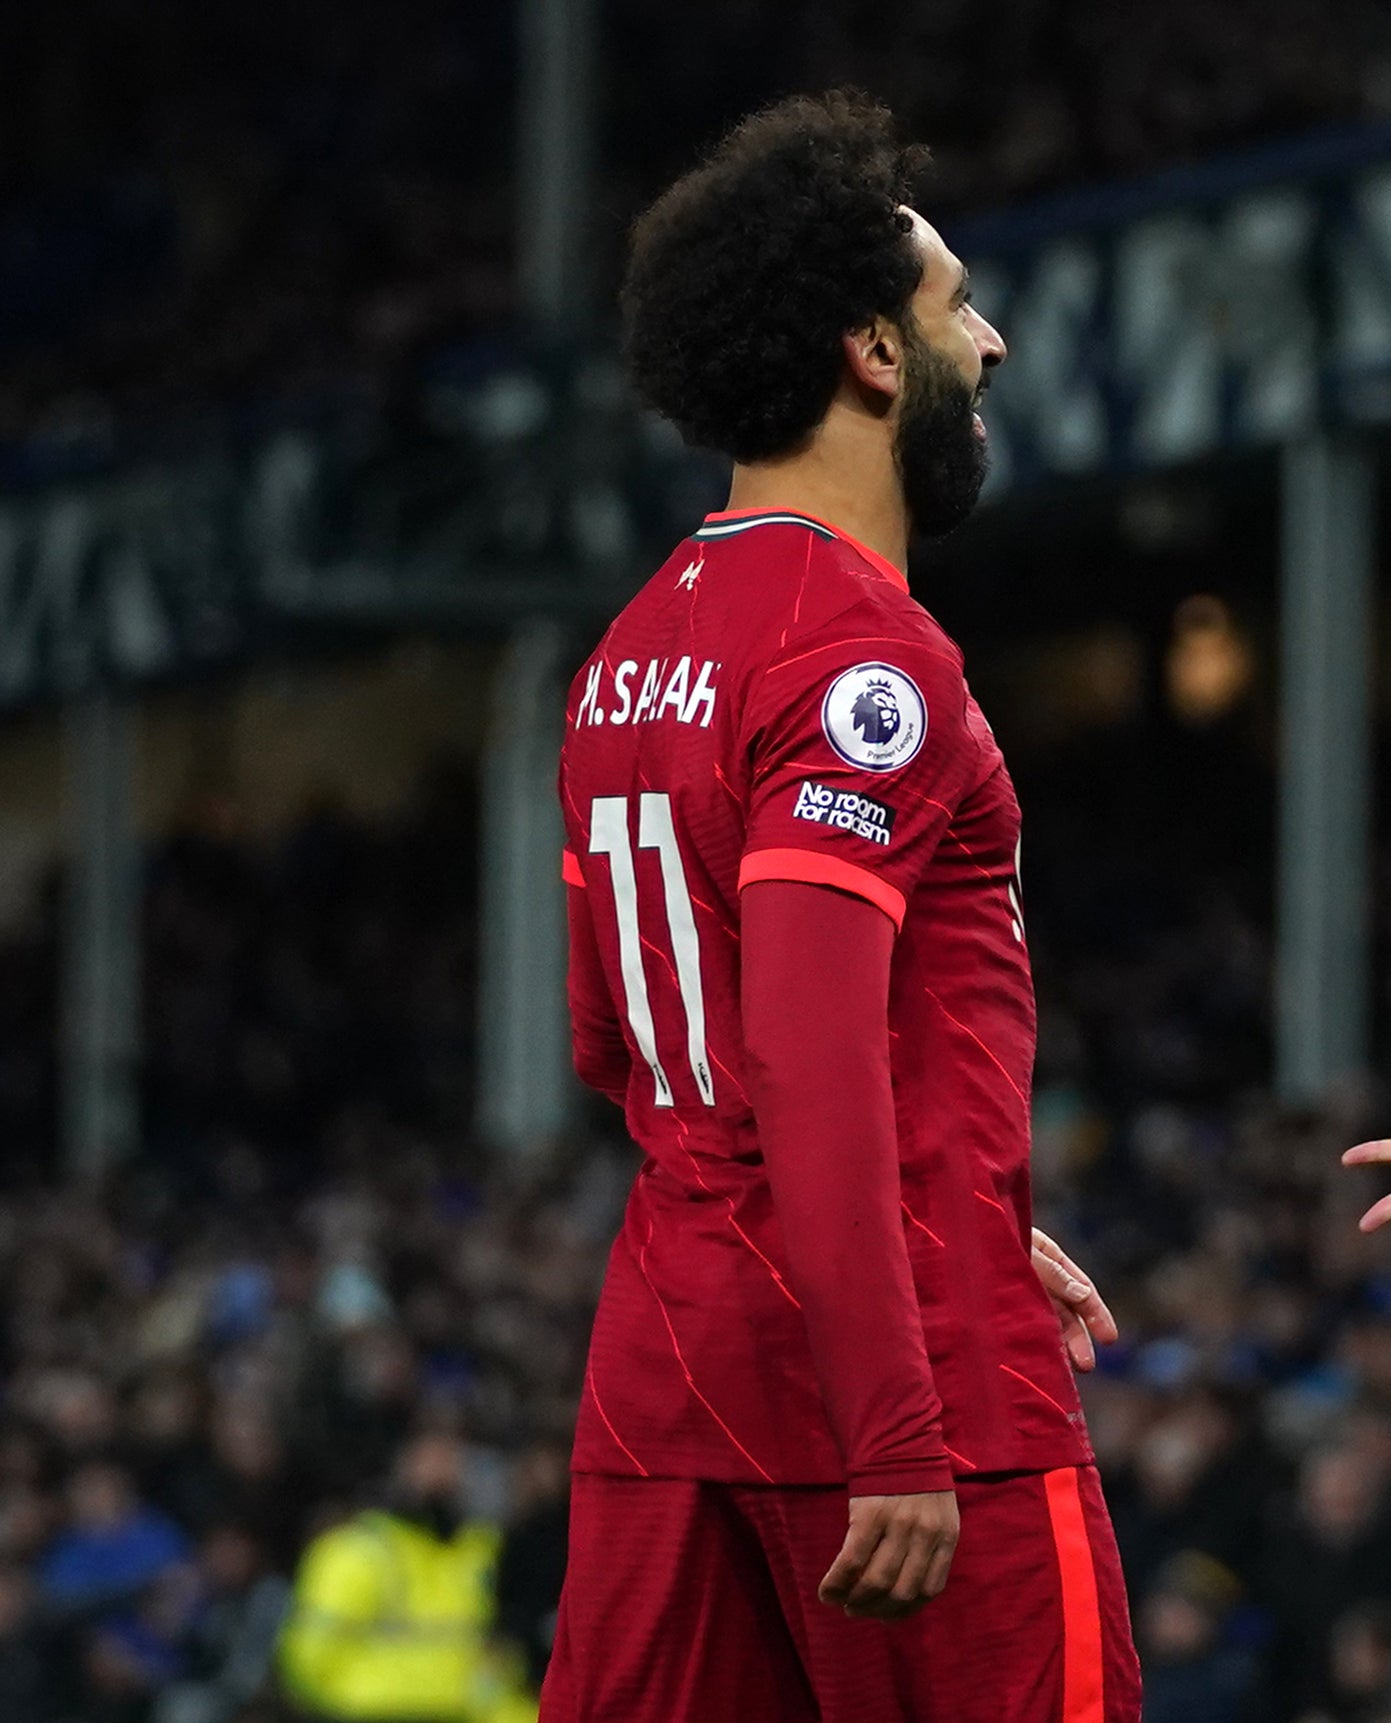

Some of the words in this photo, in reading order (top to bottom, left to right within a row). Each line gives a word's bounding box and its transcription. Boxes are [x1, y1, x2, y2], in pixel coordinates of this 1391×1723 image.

[866, 750, 896, 760] Premier
[895, 722, 914, 752] League
[799, 781, 834, 807] No
[834, 793, 886, 826] room
[827, 809, 890, 846] racism
[588, 792, 717, 1108] 11
